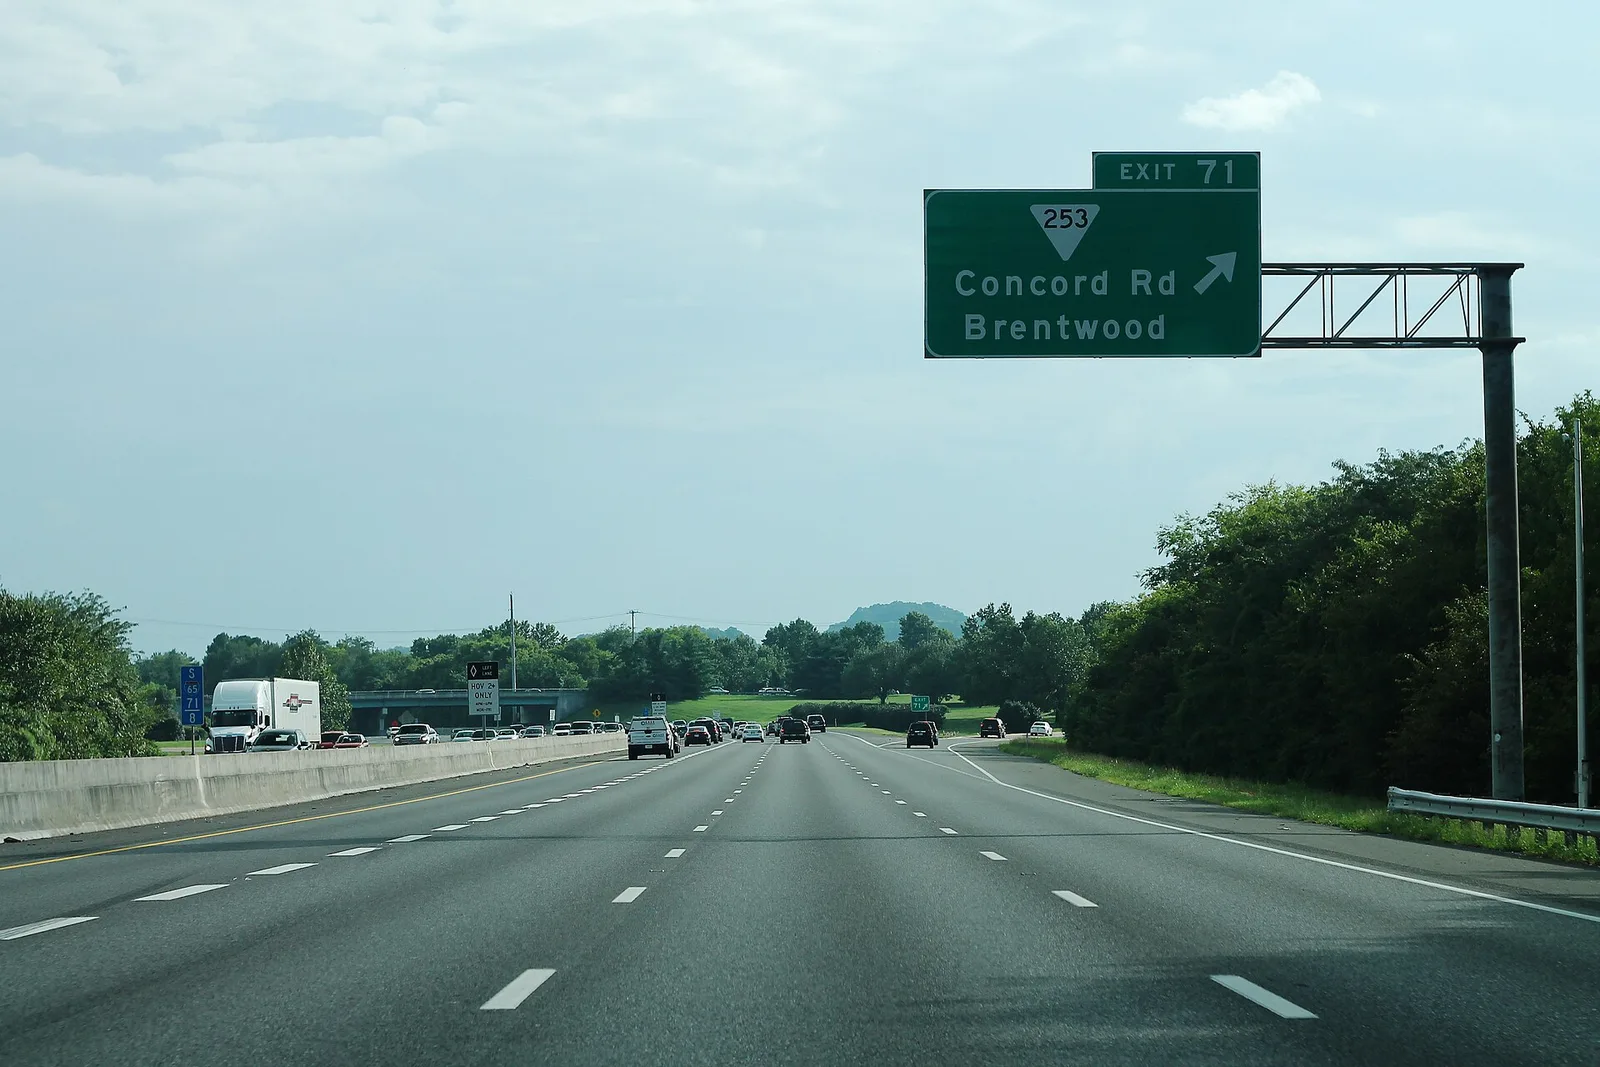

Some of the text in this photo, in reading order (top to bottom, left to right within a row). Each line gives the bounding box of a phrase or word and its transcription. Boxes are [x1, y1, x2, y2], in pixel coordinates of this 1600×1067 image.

[1120, 159, 1233, 184] EXIT 71
[1043, 208, 1088, 229] 253
[955, 269, 1175, 296] Concord Rd
[965, 313, 1165, 340] Brentwood
[188, 668, 195, 679] S
[187, 684, 198, 694] 65
[186, 698, 198, 708] 71
[190, 712, 196, 724] 8
